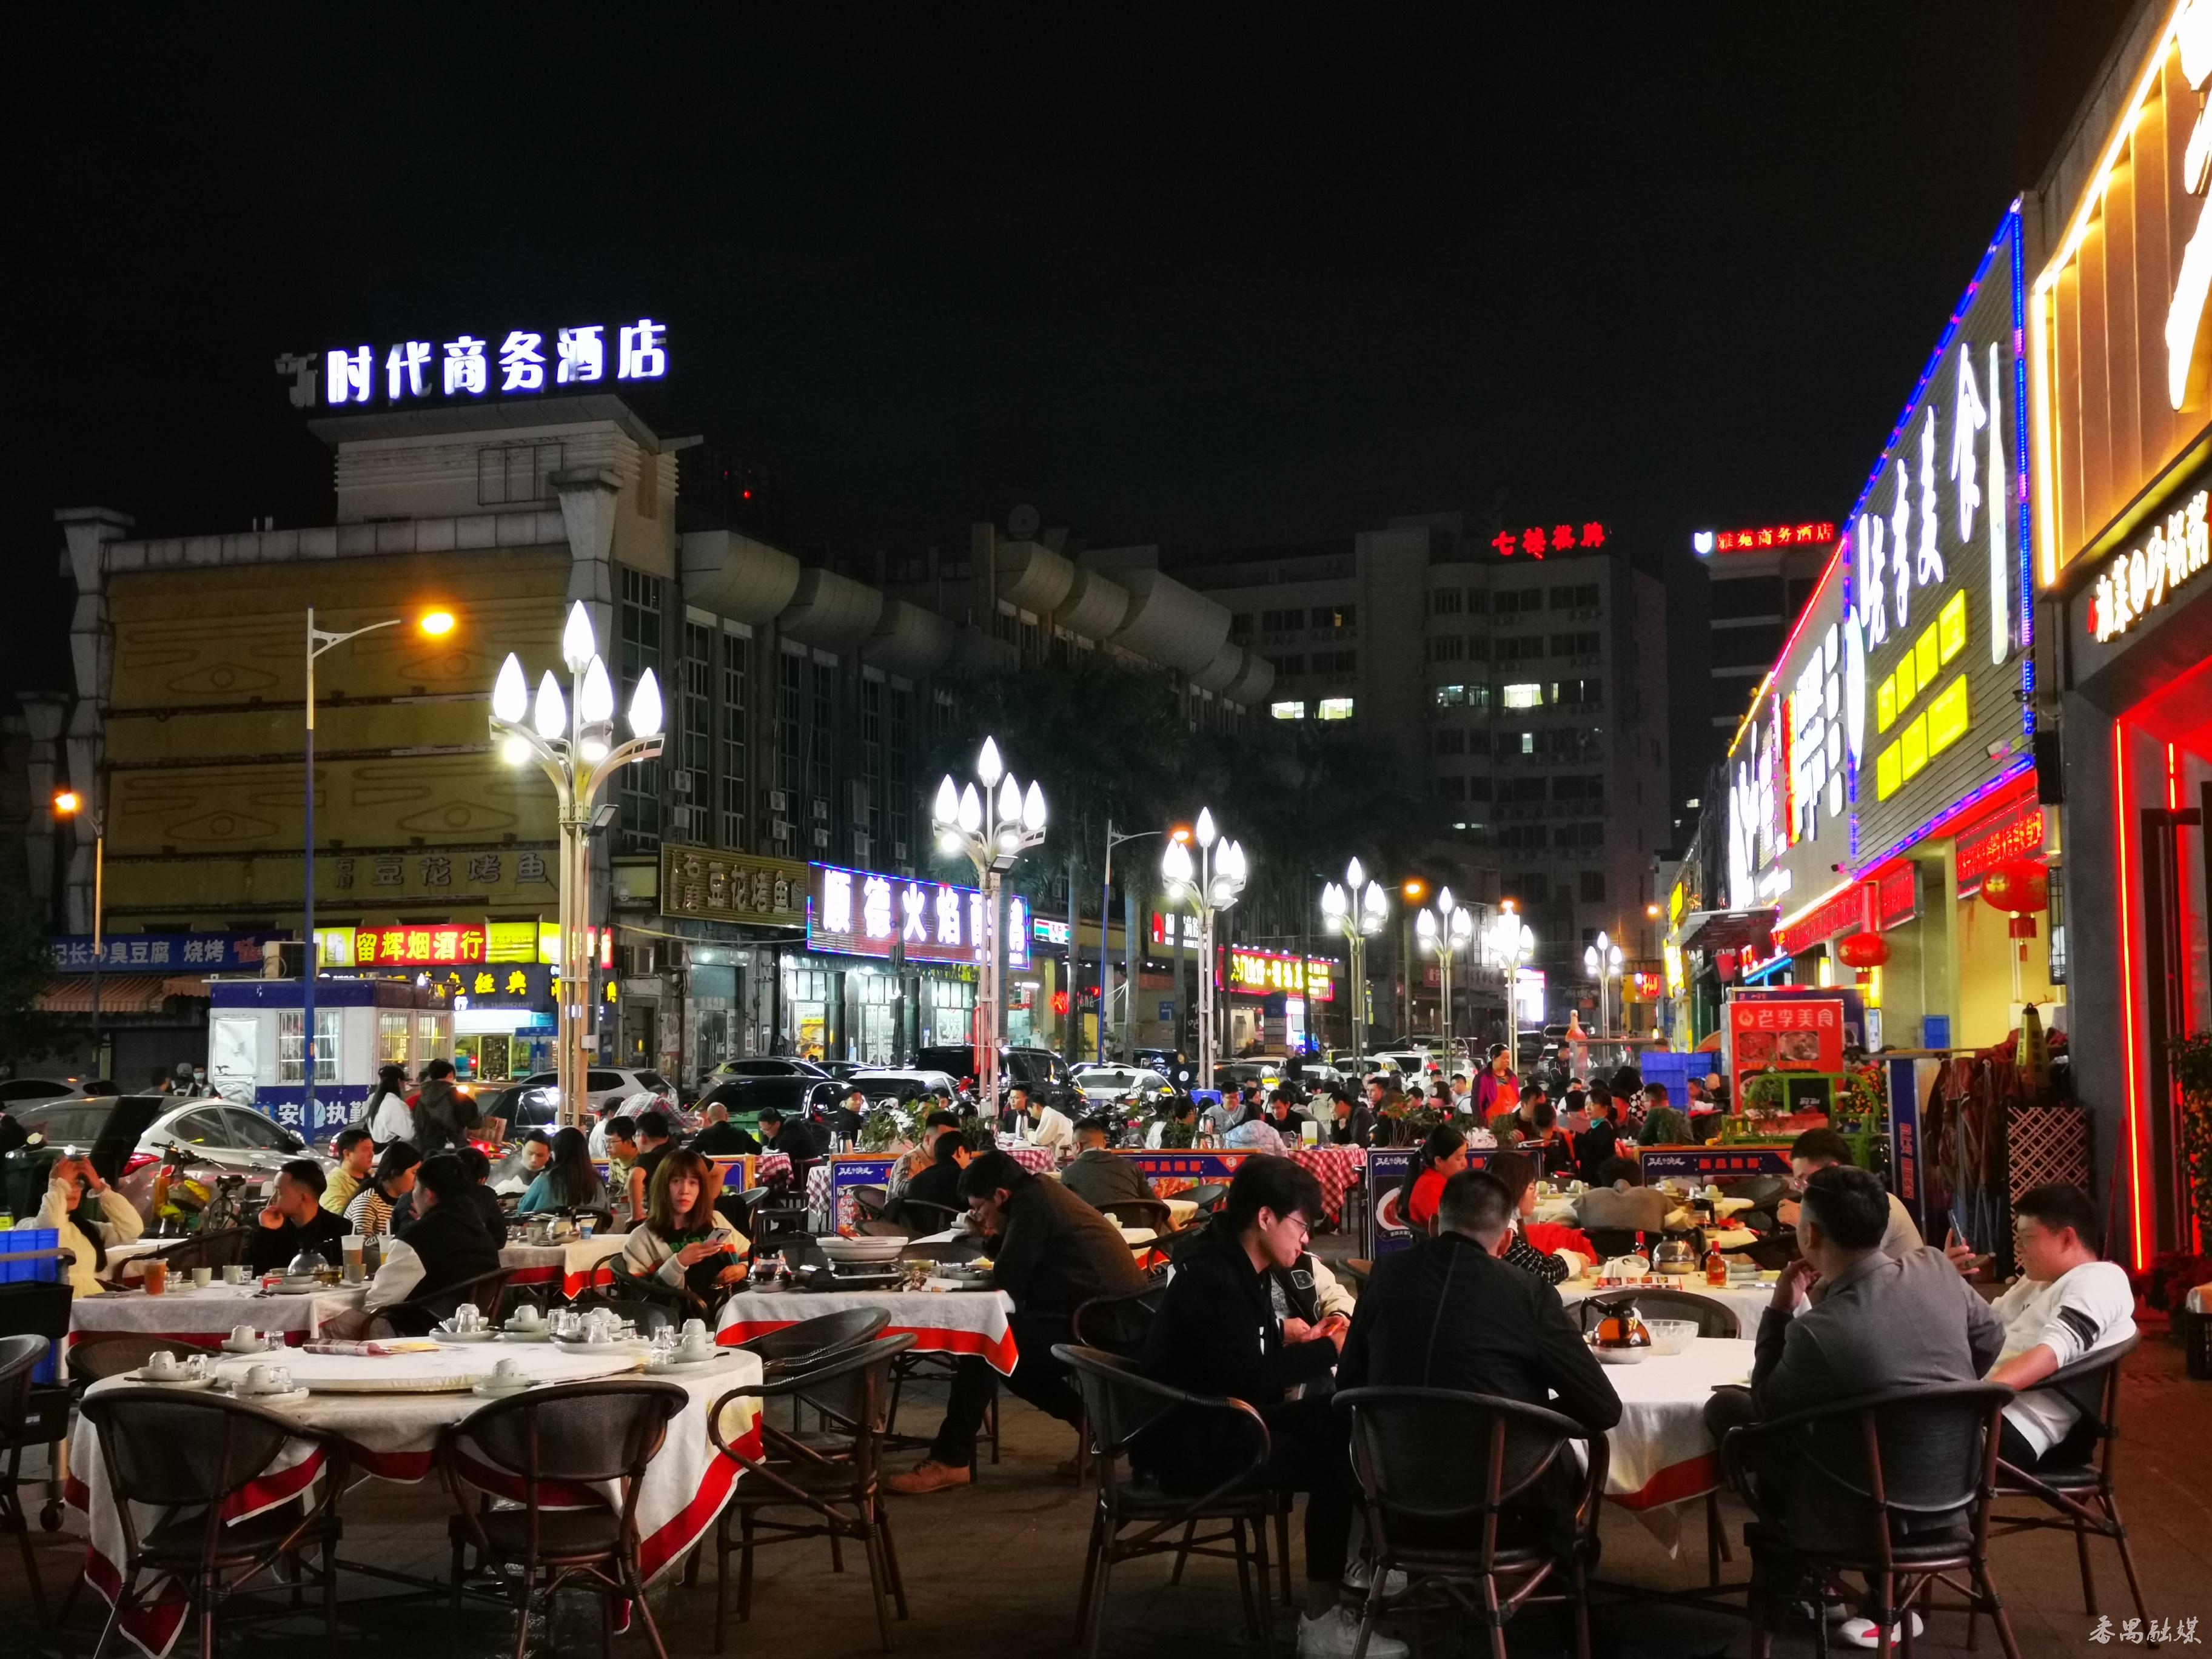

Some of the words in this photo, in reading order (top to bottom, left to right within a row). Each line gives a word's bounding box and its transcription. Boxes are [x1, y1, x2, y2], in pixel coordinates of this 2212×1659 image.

[1717, 523, 1834, 551] 雅苑商务酒店
[184, 939, 225, 964] 烧烤
[356, 931, 484, 962] 留辉烟酒行
